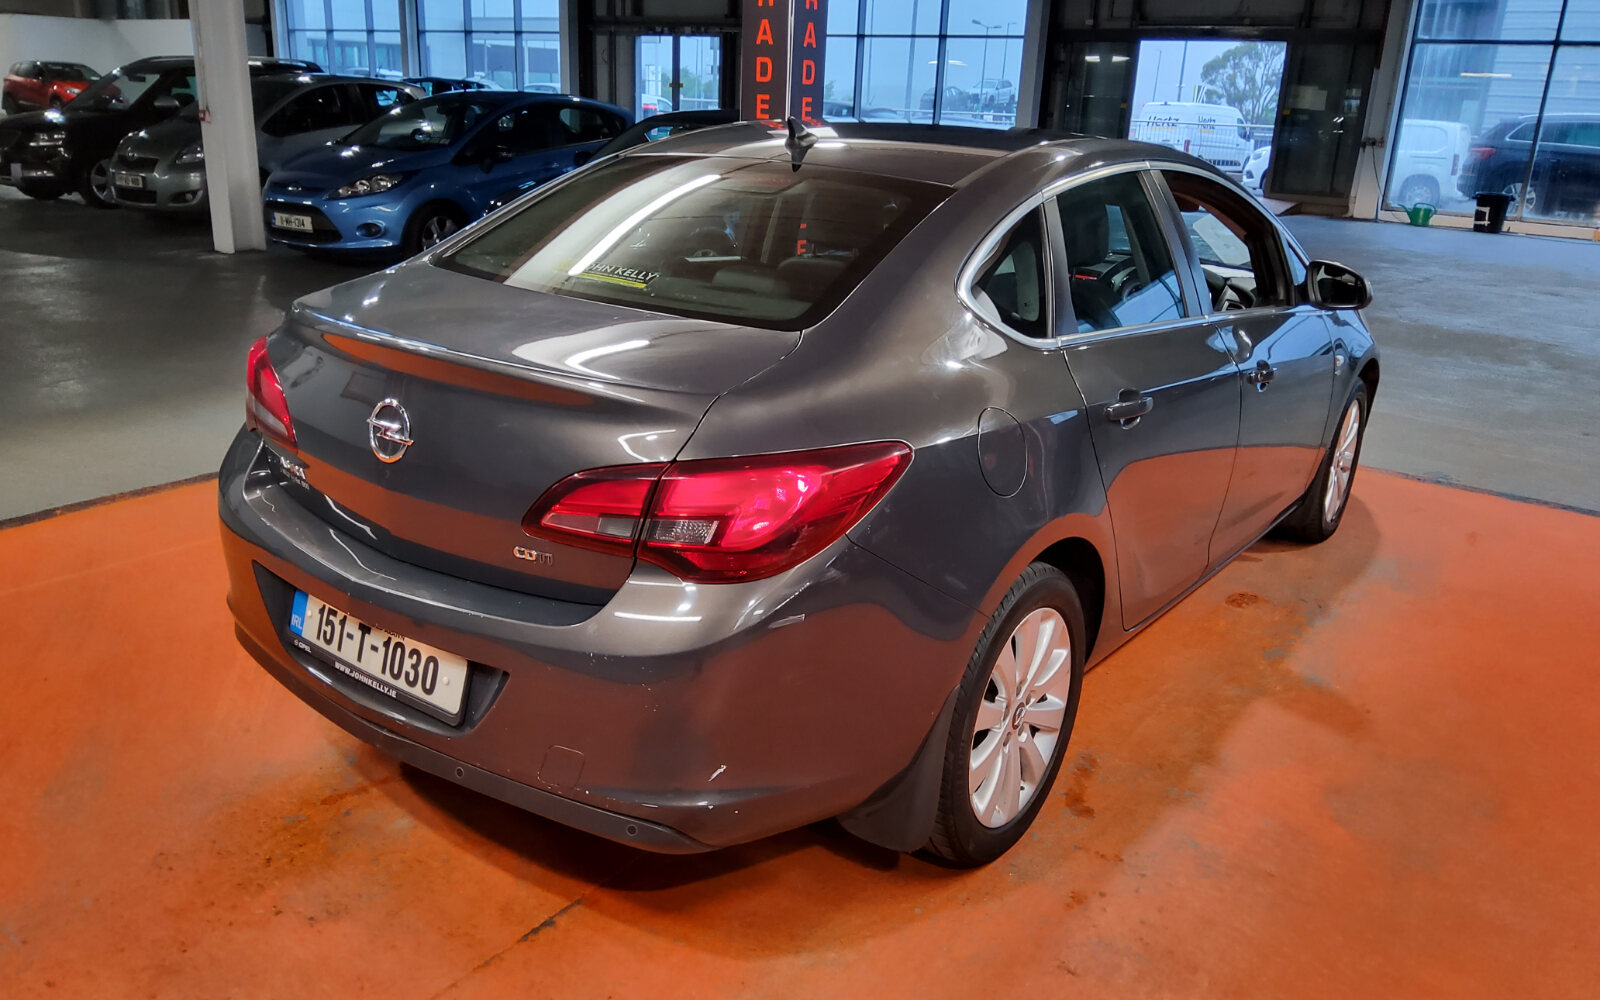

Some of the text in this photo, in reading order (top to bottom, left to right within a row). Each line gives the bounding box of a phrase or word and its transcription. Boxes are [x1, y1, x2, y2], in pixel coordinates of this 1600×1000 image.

[755, 0, 774, 119] ADE
[1147, 116, 1179, 127] Hertz
[615, 267, 657, 280] KELLY
[291, 614, 302, 629] IRL
[316, 603, 439, 696] 151-T-1030
[334, 660, 397, 698] WWW.JOHNKELLY.IE
